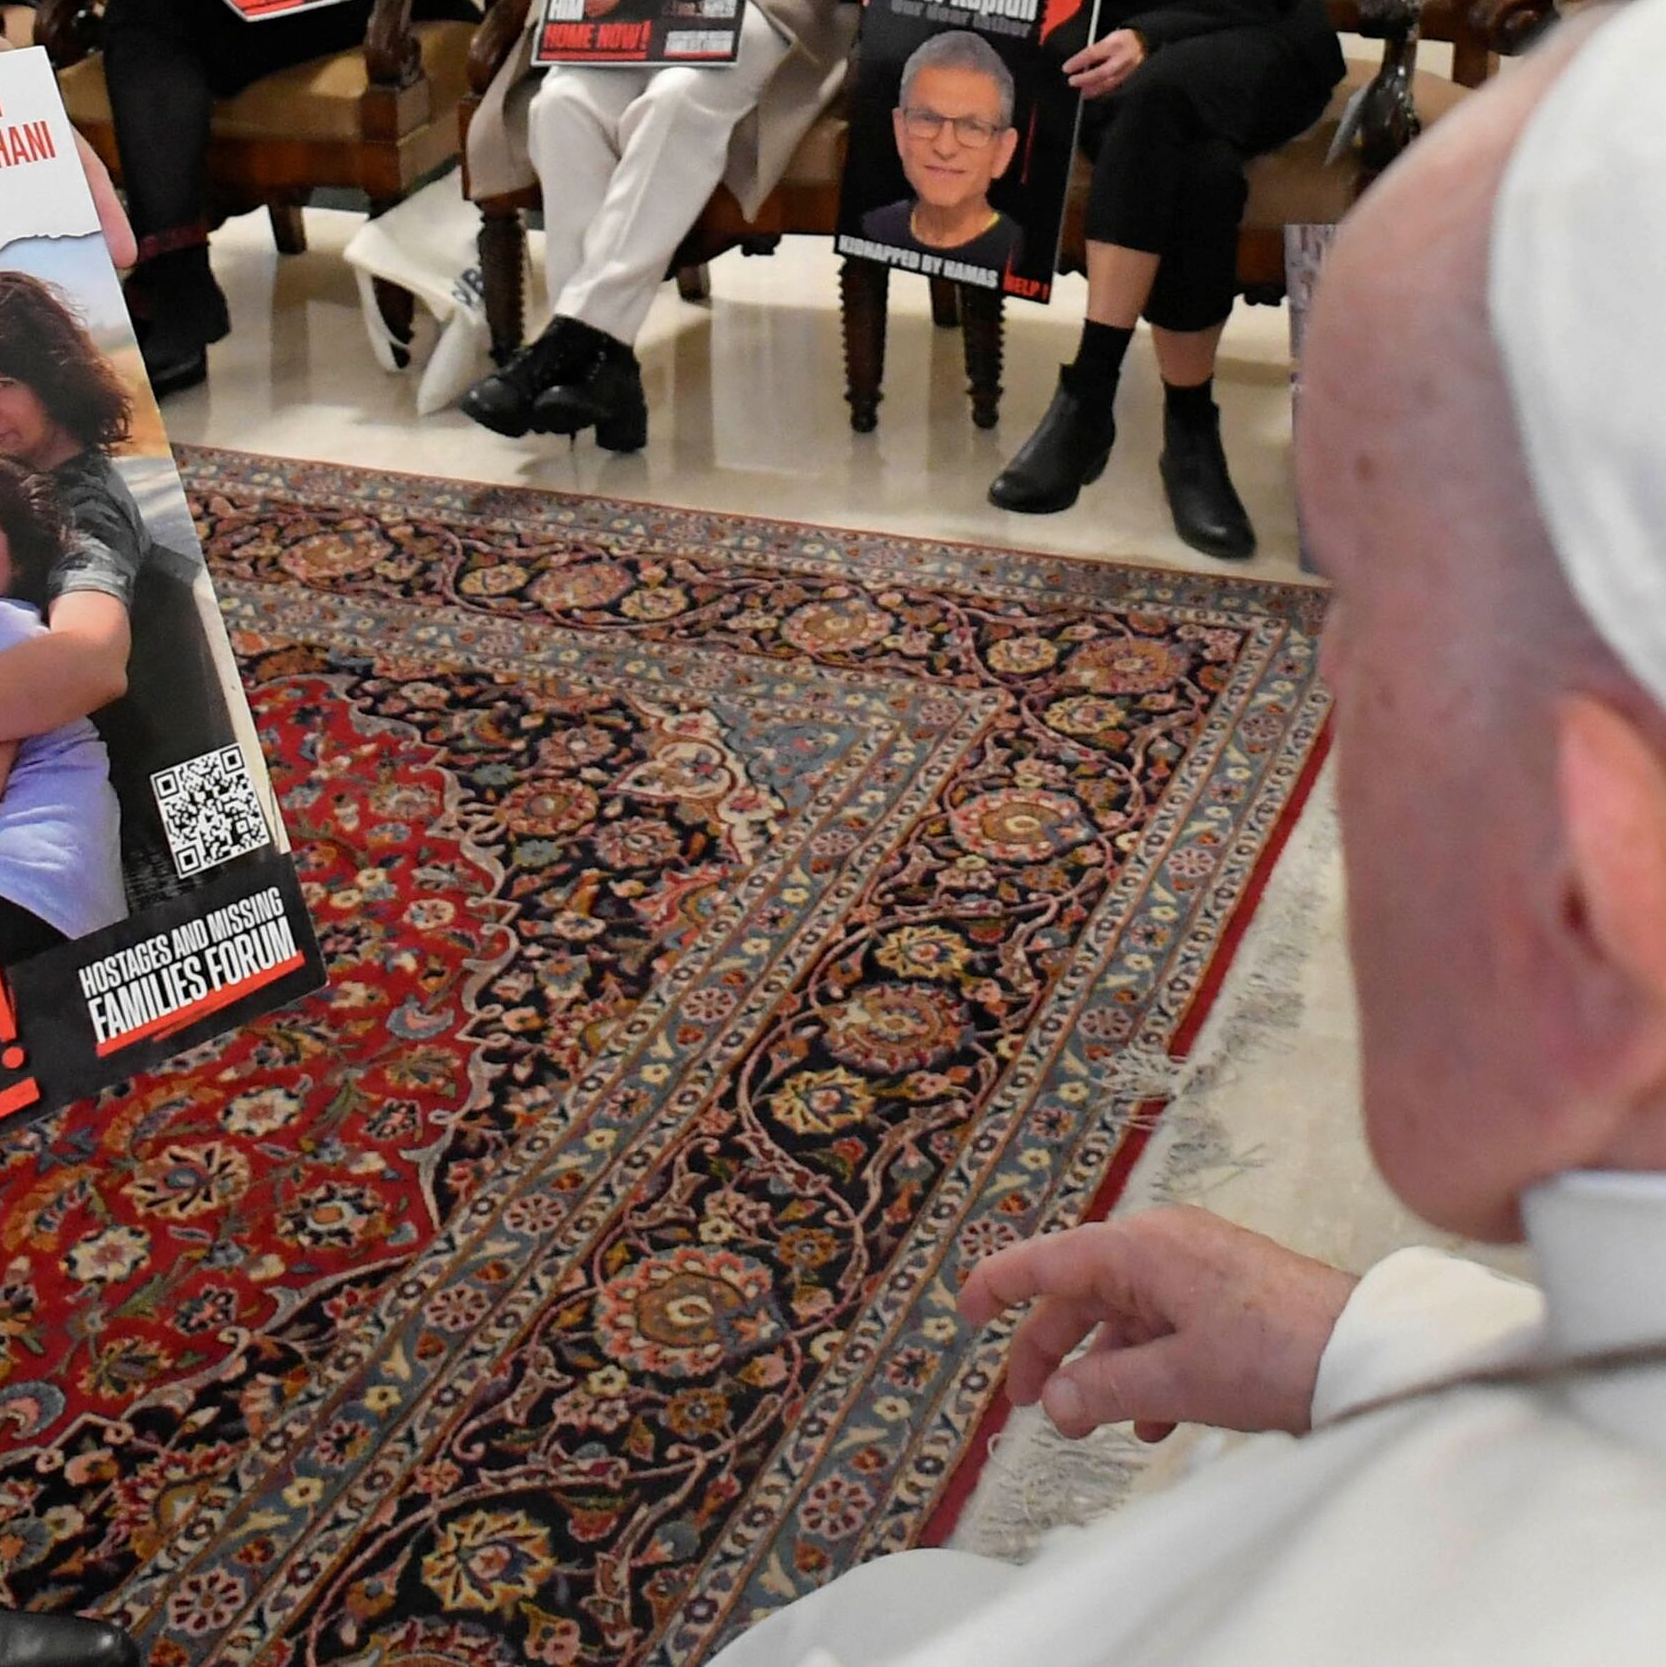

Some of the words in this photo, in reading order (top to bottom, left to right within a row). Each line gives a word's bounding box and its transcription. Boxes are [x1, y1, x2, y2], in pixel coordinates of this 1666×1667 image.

[543, 22, 595, 49] HOME
[595, 20, 652, 49] NOW!
[837, 234, 921, 270] KIDNAPPED
[920, 253, 944, 275] BY
[942, 259, 999, 290] HAMAS
[78, 934, 173, 999] HOSTAGES
[171, 919, 210, 960] AND
[206, 886, 285, 943] MISSING
[87, 955, 208, 1044] FAMILIES
[204, 916, 298, 993] FORUM
